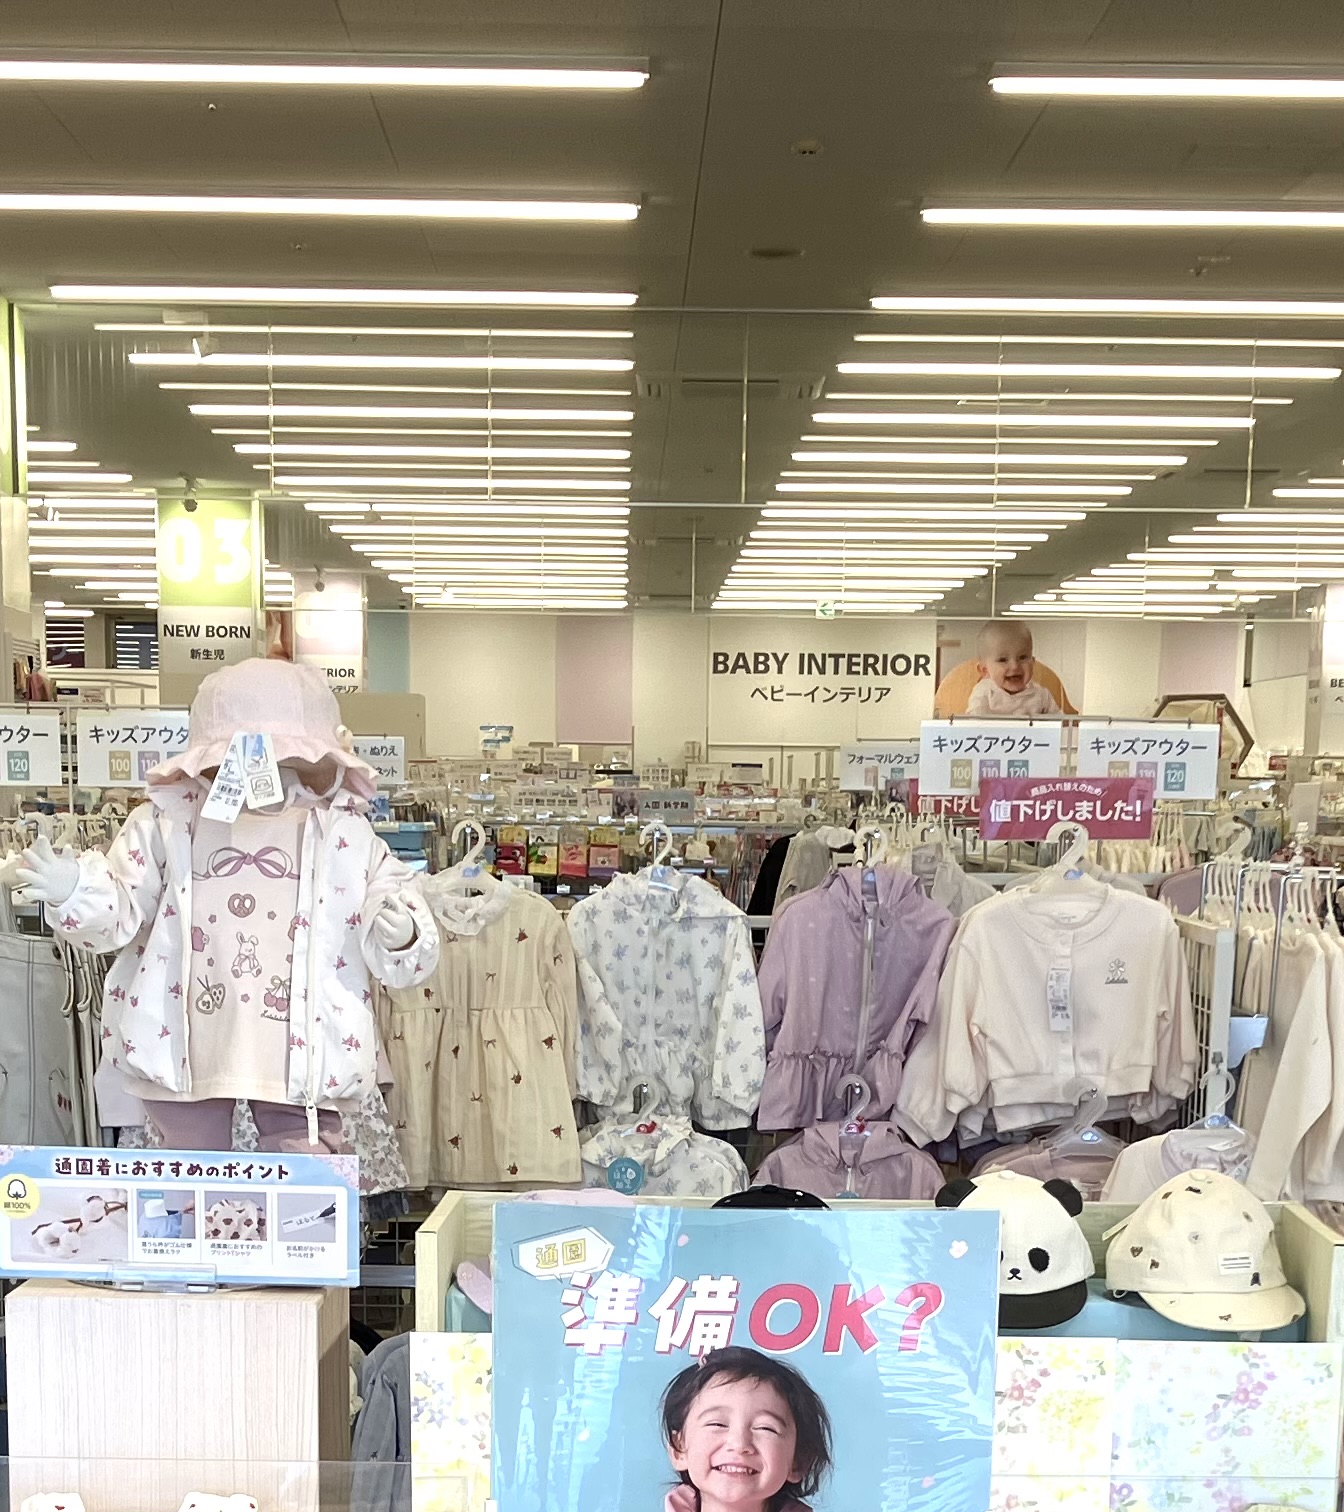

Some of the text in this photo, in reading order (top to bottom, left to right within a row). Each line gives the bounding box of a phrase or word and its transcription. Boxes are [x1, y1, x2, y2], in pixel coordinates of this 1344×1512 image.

[159, 517, 253, 584] 03
[163, 624, 251, 639] NEW BORN
[190, 649, 225, 660] 新生児
[324, 668, 355, 678] RIOR
[712, 653, 931, 677] BABY INTERIOR
[751, 685, 891, 704] ベビーインテリア
[89, 726, 189, 744] キッズアウタ
[932, 735, 1050, 753] キッズアウター
[1090, 737, 1208, 755] キッズアウター
[9, 758, 28, 772] 120
[110, 759, 130, 772] 100
[952, 766, 970, 780] 100
[1166, 769, 1184, 783] 120
[990, 800, 1142, 822] 値下げしました!
[55, 1157, 289, 1180] 通園着におすすめのポイント
[535, 1237, 587, 1269] 通園
[560, 1270, 945, 1357] 準備OK?
